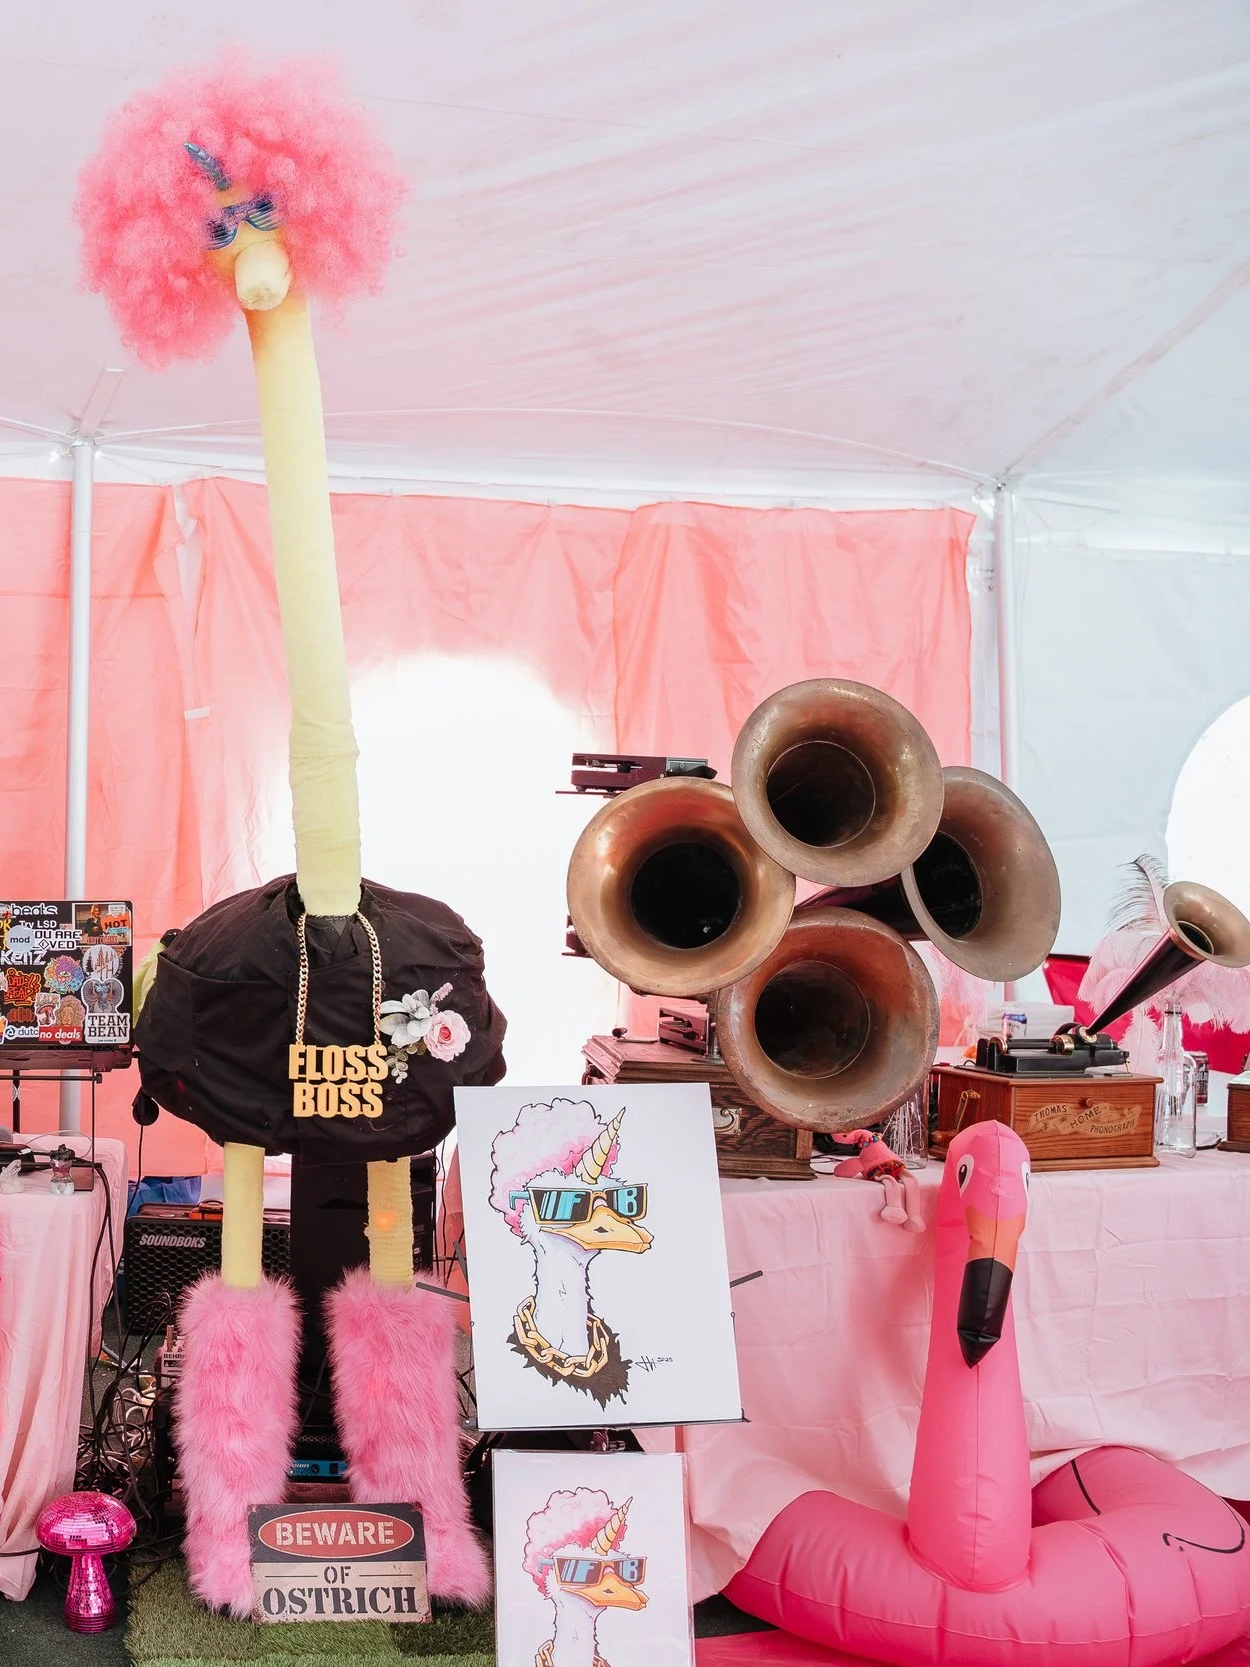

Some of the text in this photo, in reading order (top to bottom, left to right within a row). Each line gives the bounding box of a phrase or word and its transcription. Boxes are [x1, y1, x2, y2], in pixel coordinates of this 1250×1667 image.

[11, 903, 58, 916] beats
[37, 920, 57, 929] LSD
[104, 919, 127, 929] HOT
[34, 930, 51, 939] OU
[55, 930, 82, 940] ARE
[87, 1014, 128, 1026] TEAM
[18, 1027, 39, 1036] dutc
[39, 1028, 81, 1039] no deals
[88, 1026, 128, 1037] BEAN
[288, 1043, 388, 1081] FLOSS
[293, 1081, 383, 1118] BOSS
[1033, 1104, 1067, 1122] THOMAS
[1070, 1106, 1102, 1129] HOME
[1089, 1118, 1136, 1135] PHONOGRAPH
[139, 1234, 206, 1249] SOUNDBOKS
[275, 1521, 395, 1546] BEWARE
[323, 1565, 352, 1584] OF
[262, 1586, 419, 1616] OSTRICH
